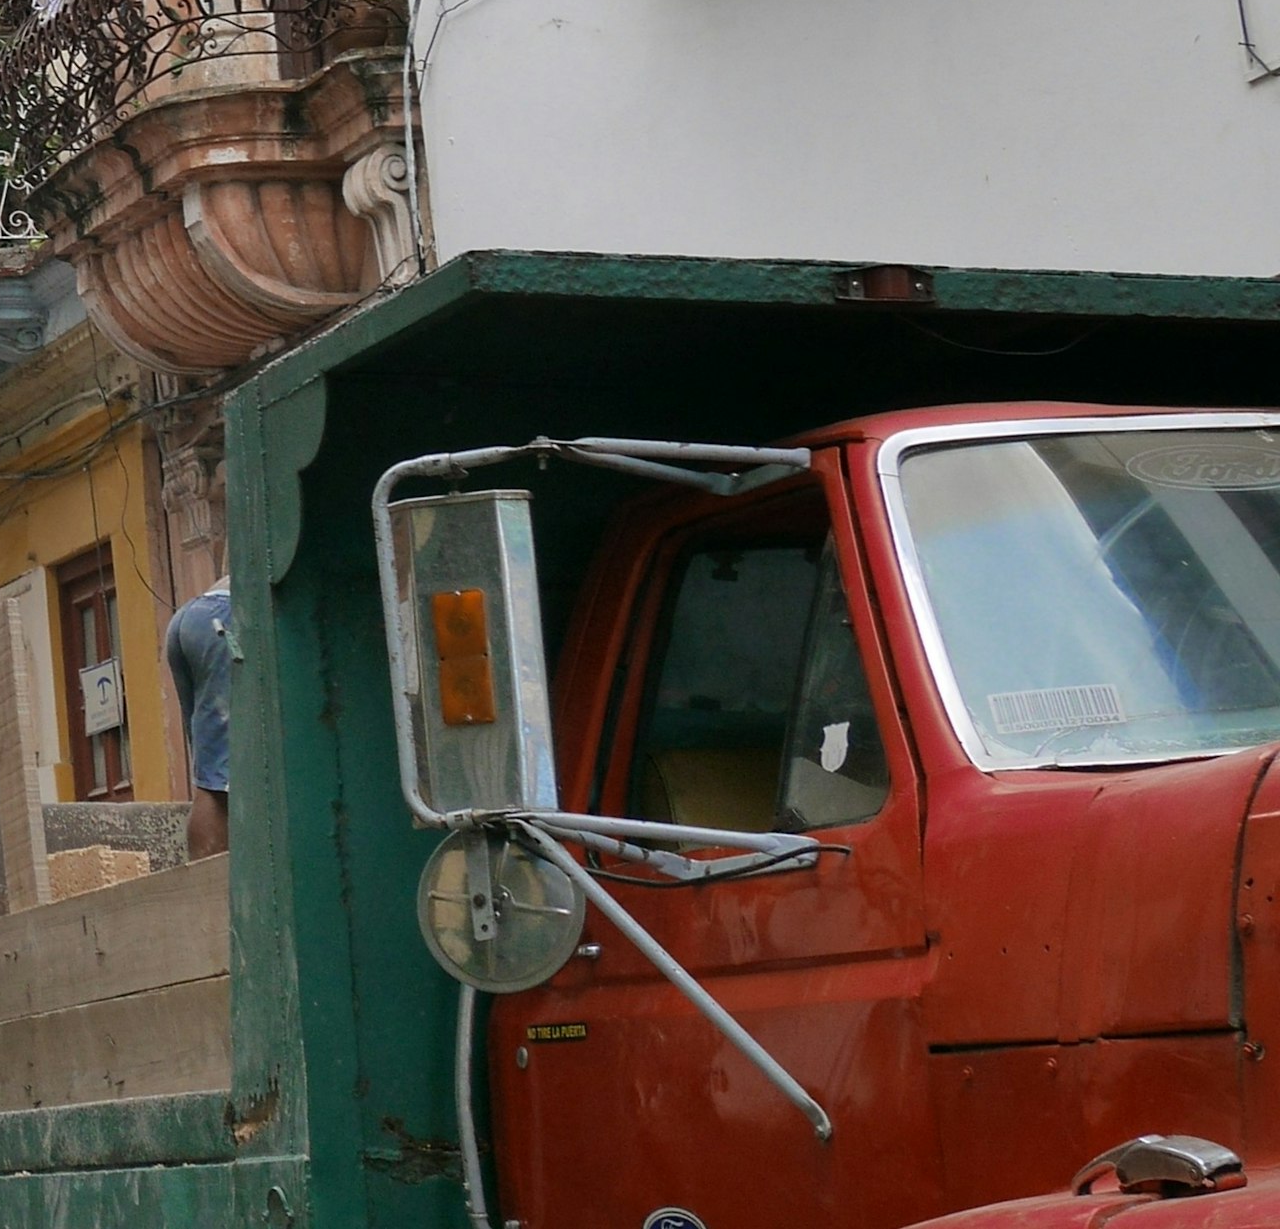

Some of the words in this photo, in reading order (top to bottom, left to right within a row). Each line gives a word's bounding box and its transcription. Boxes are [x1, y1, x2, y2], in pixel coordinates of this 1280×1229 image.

[527, 1028, 537, 1039] NO
[537, 1027, 551, 1039] TIRE
[552, 1026, 560, 1038] LA
[561, 1025, 586, 1038] PUERTA
